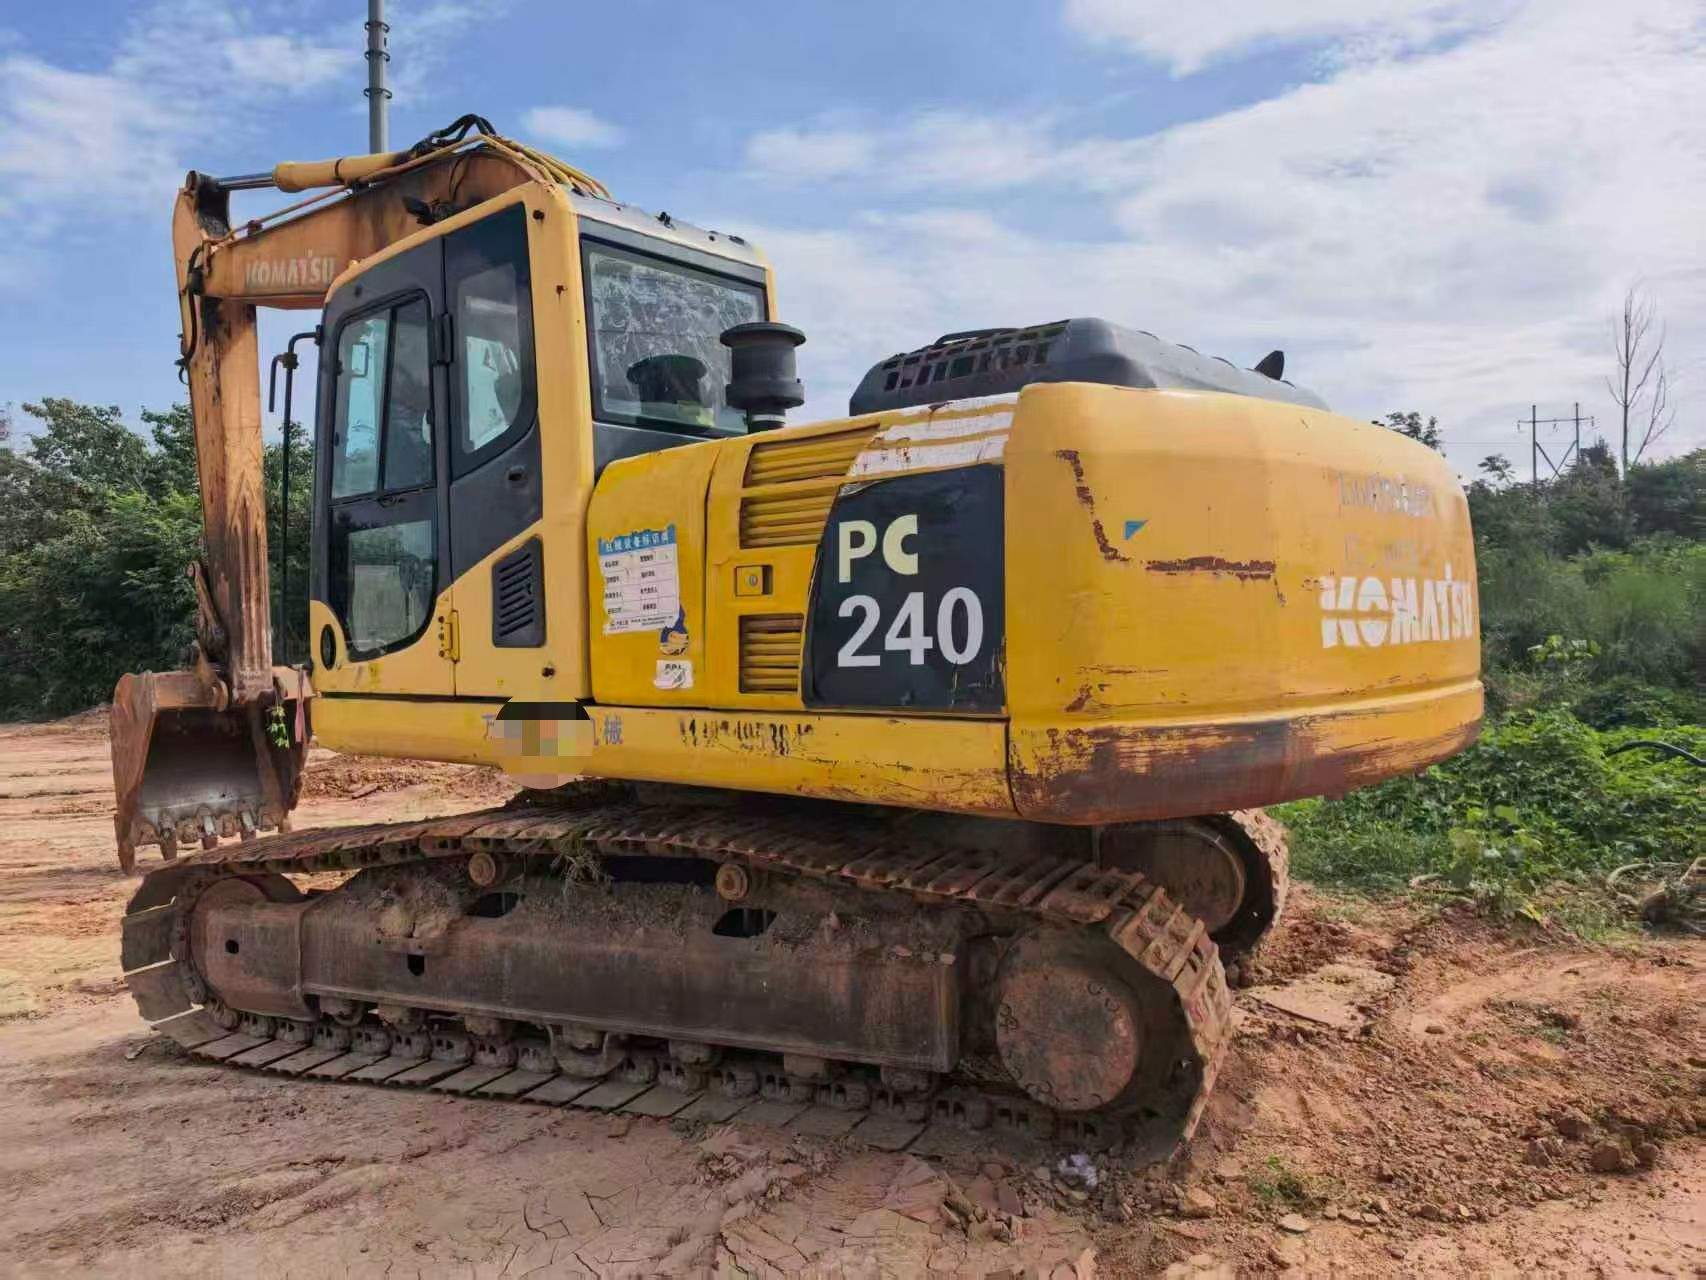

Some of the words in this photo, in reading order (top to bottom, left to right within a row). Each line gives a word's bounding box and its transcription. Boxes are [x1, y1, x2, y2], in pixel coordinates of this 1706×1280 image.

[245, 248, 334, 288] KOMATSU
[838, 514, 919, 583] PC
[837, 586, 984, 668] 240
[1319, 563, 1473, 649] KOMATSU
